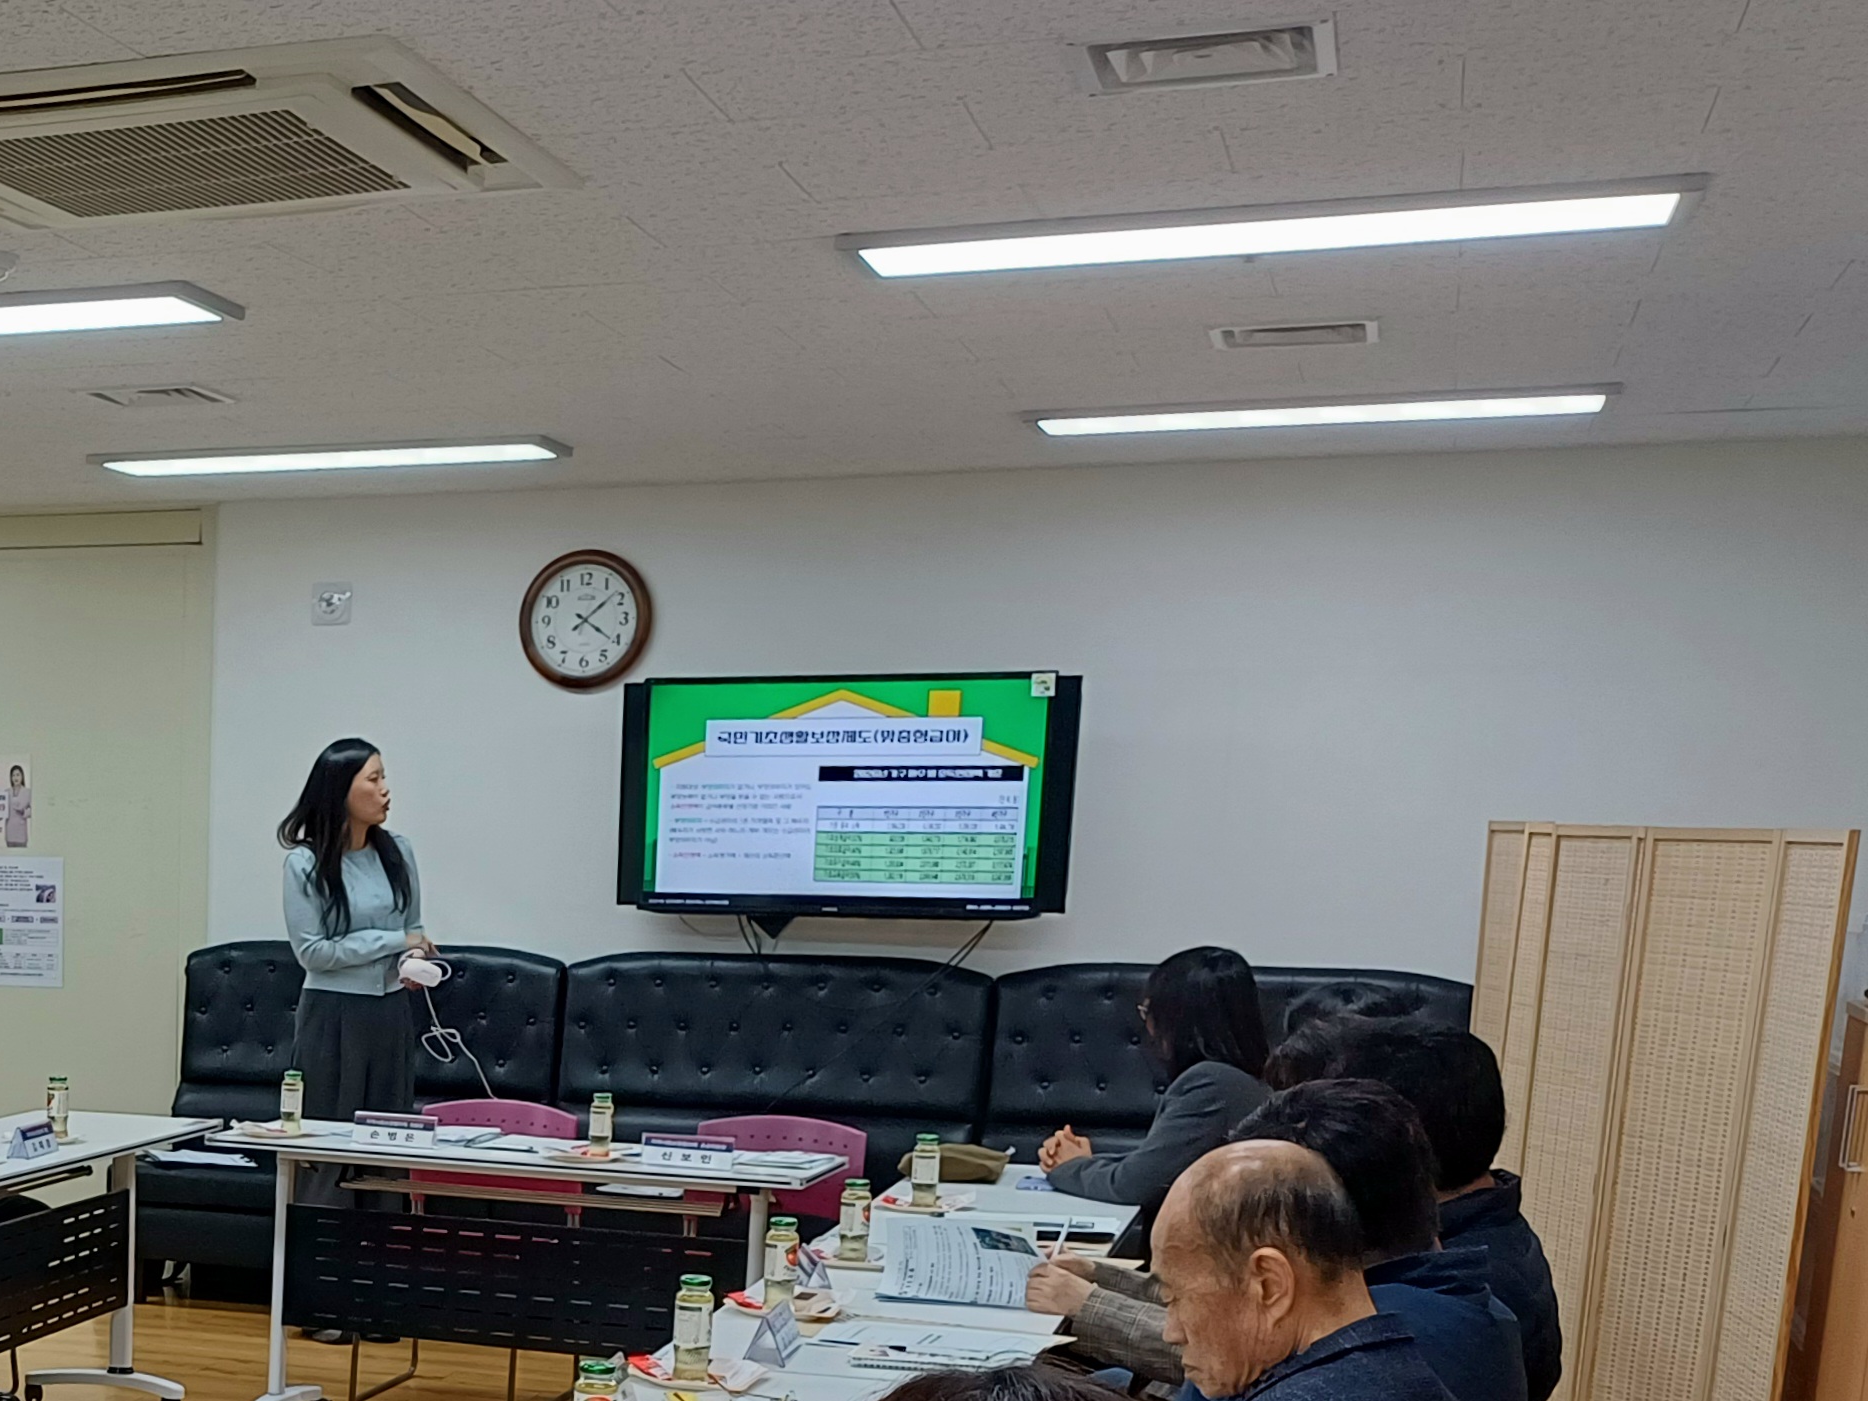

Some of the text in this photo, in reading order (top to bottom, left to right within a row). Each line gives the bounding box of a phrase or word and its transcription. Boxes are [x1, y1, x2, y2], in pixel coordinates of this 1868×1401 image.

[560, 579, 570, 592] 11
[580, 572, 593, 586] 12
[605, 577, 609, 591] 1
[545, 595, 560, 609] 10
[617, 592, 625, 606] 2
[541, 615, 552, 628] 9
[619, 611, 629, 626] 3
[546, 634, 556, 649] 8
[612, 633, 621, 646] 4
[560, 650, 568, 664] 7
[579, 655, 589, 668] 6
[598, 649, 608, 663] 5
